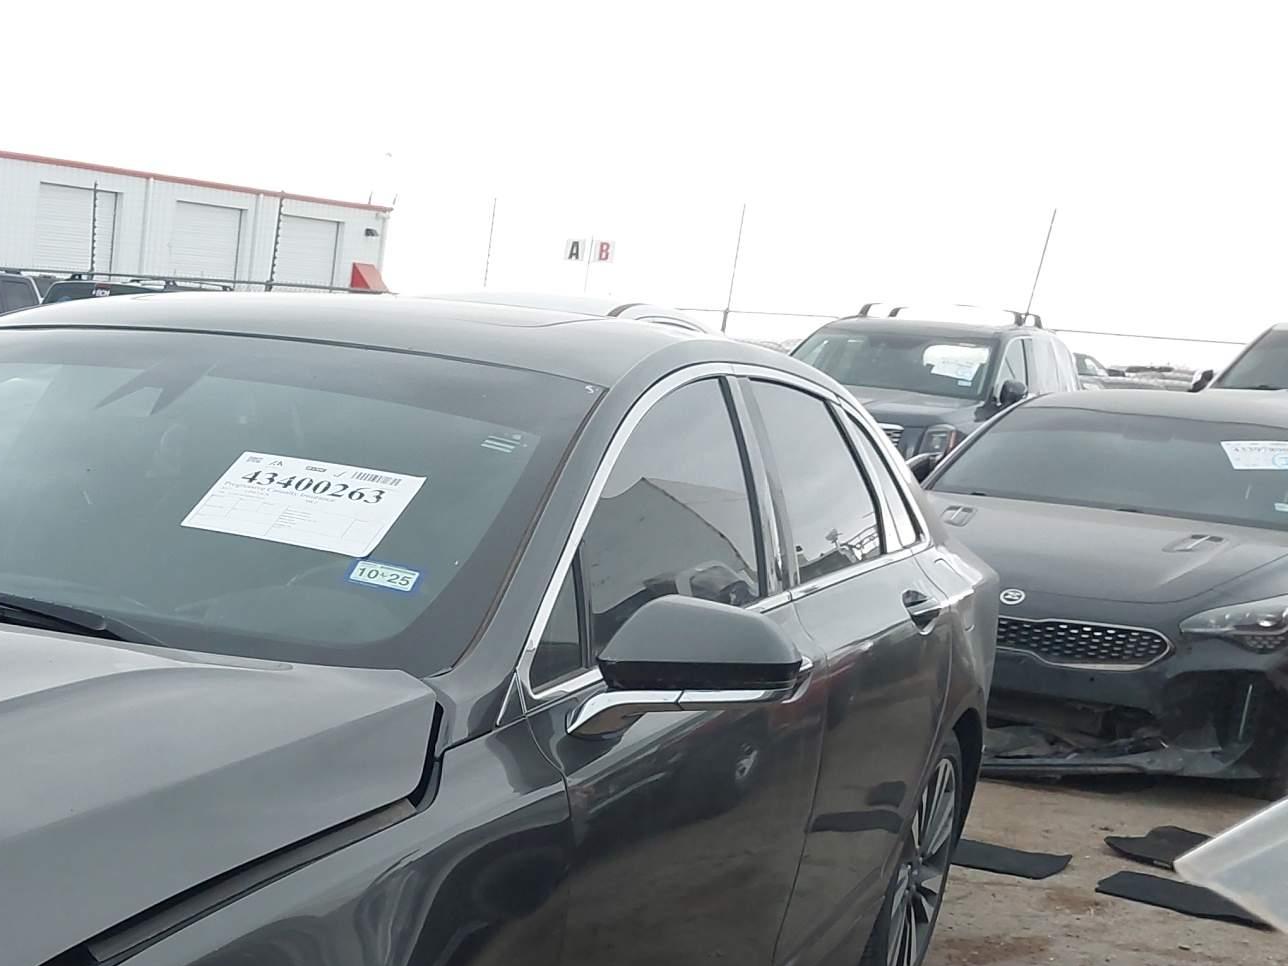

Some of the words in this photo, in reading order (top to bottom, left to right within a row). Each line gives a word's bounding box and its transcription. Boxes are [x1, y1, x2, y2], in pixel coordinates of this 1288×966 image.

[568, 241, 580, 260] A
[599, 241, 610, 261] B
[241, 470, 387, 504] 43400263
